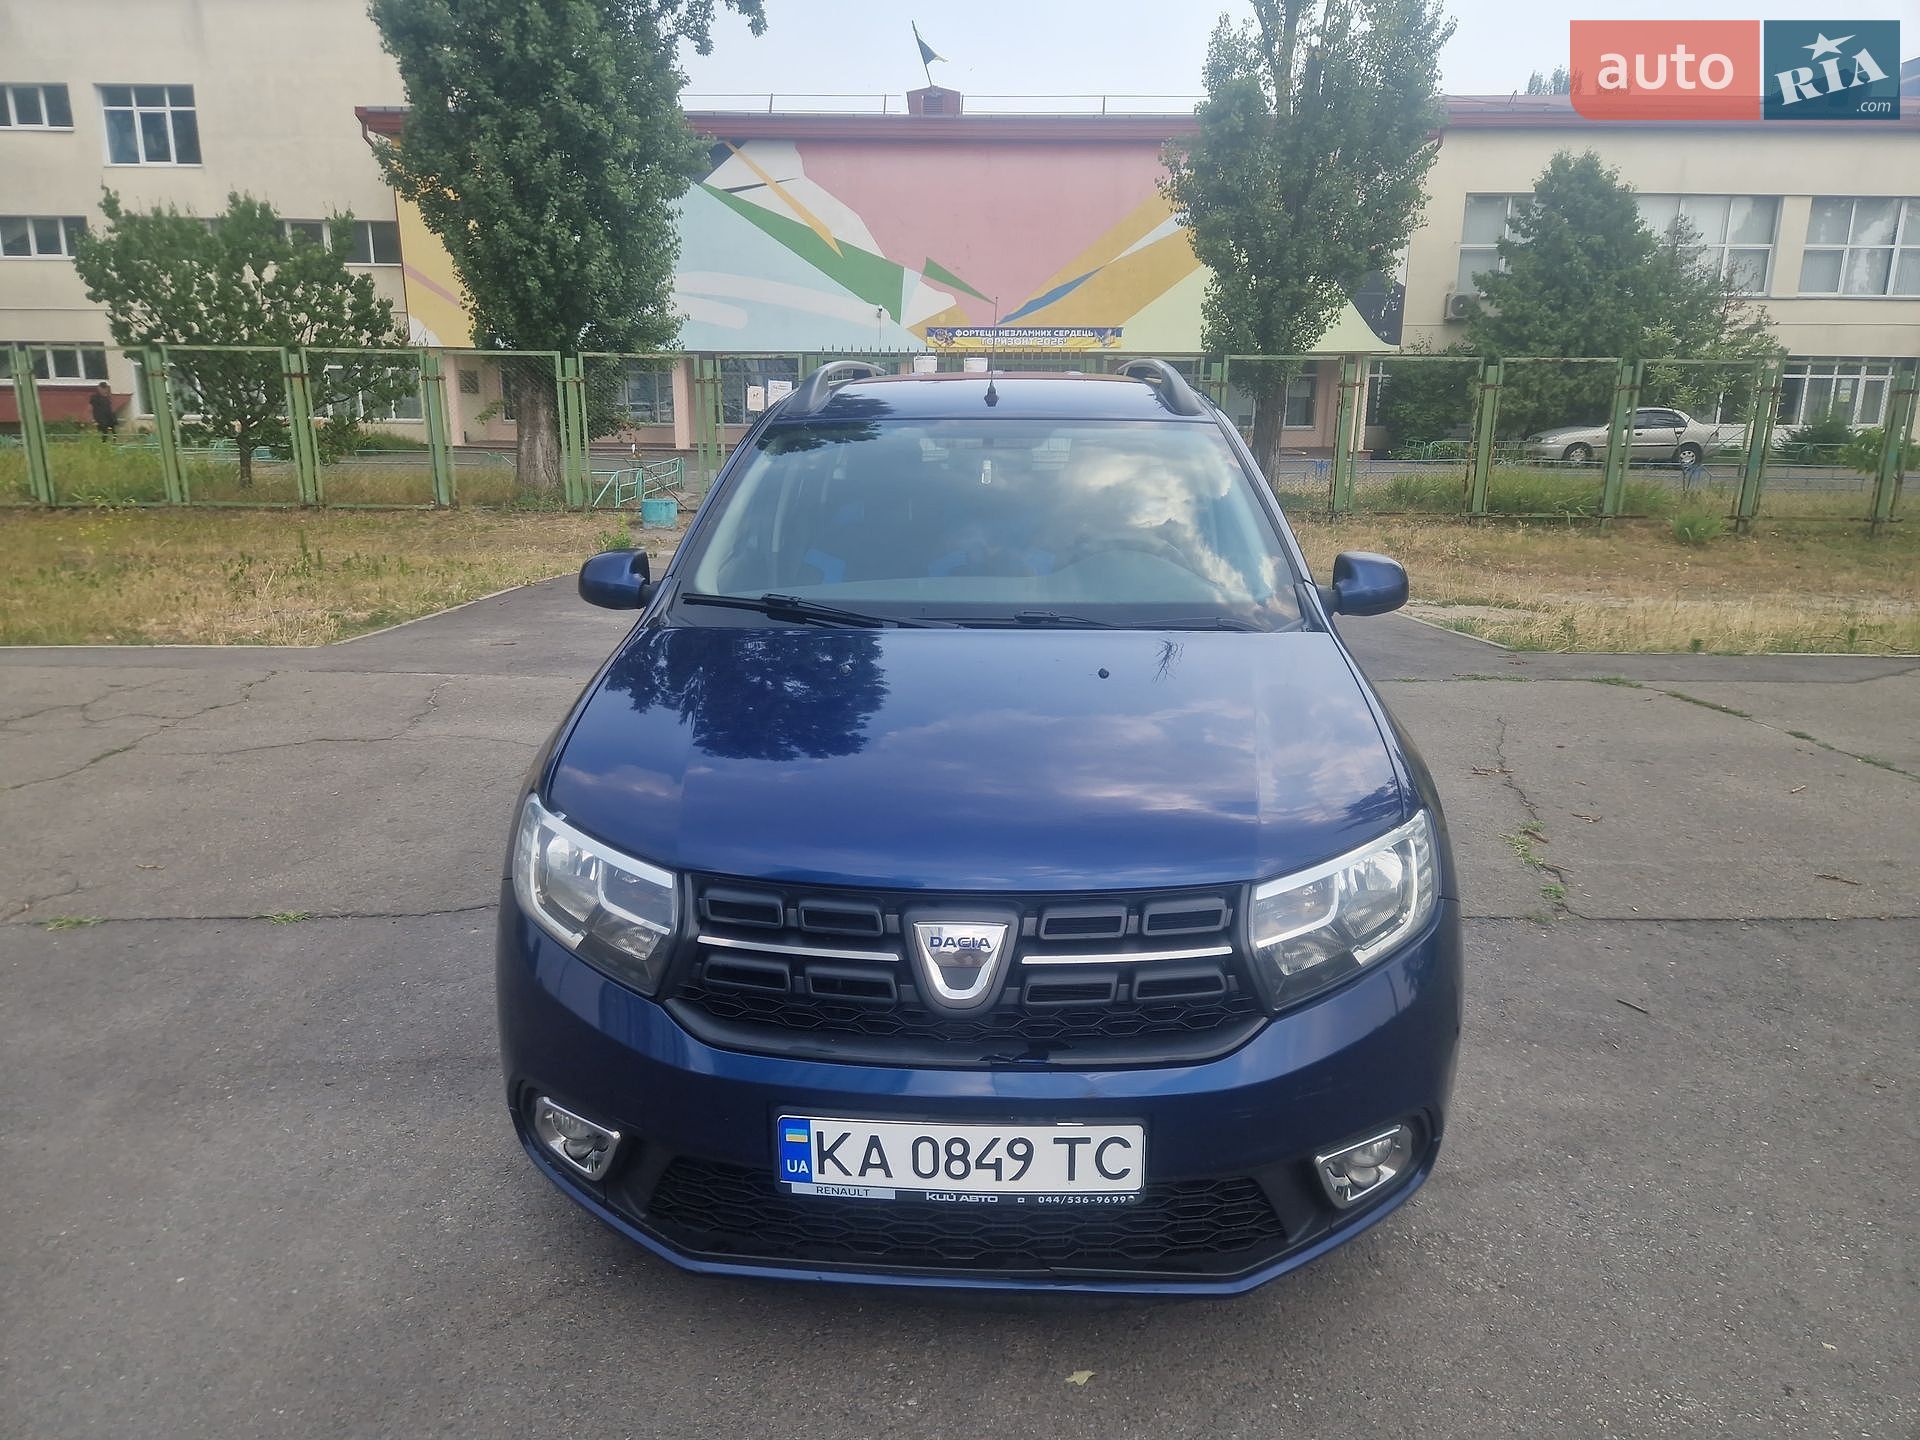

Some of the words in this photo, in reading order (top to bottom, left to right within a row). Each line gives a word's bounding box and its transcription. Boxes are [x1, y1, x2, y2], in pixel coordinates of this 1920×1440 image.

[998, 329, 1051, 337] НЕЗЛАМНИХ
[1053, 329, 1094, 337] СЕРДЕЦЬ
[929, 936, 991, 949] DACIA
[816, 1131, 893, 1178] KA
[911, 1135, 1035, 1182] 0849
[1053, 1136, 1132, 1181] TC
[786, 1159, 809, 1174] UA
[816, 1186, 871, 1197] RENAULT
[1038, 1195, 1126, 1204] 044/536-9699
